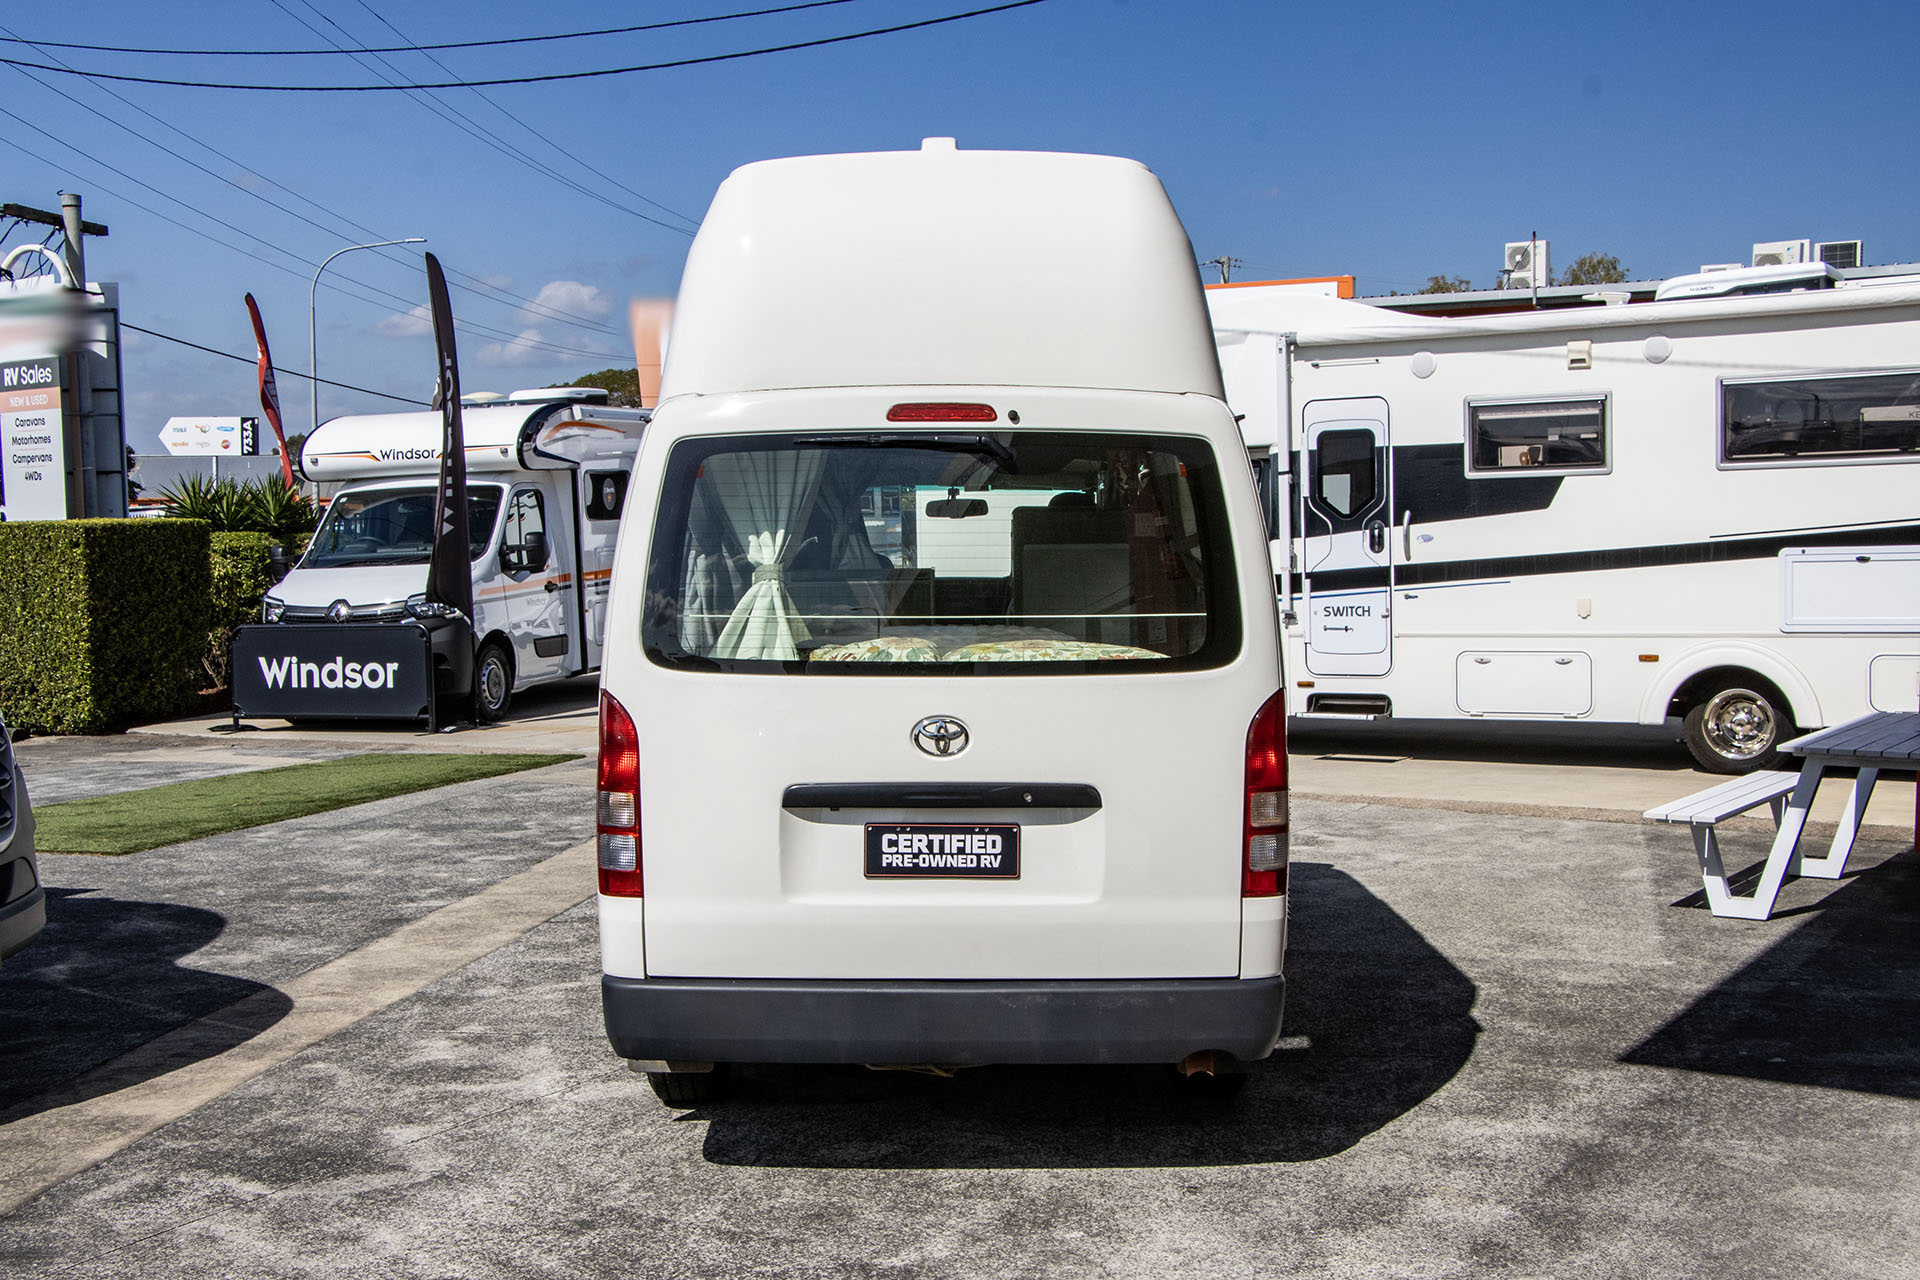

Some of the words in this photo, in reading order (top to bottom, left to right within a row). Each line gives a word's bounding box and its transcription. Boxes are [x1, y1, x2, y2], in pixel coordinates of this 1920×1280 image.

[3, 367, 19, 387] RV
[20, 364, 52, 385] Sales
[31, 394, 48, 406] USED
[15, 417, 46, 428] Caravans
[12, 435, 52, 446] Motorhomes
[242, 420, 254, 454] 733A
[12, 454, 52, 465] Campervans
[380, 448, 436, 460] Windsor
[25, 471, 42, 481] 4WDs
[1323, 606, 1371, 617] SWITCH
[257, 656, 399, 689] Windsor
[881, 833, 1003, 854] CERTIFIED
[881, 854, 978, 868] PRE-OWNED
[980, 855, 1002, 868] RV
